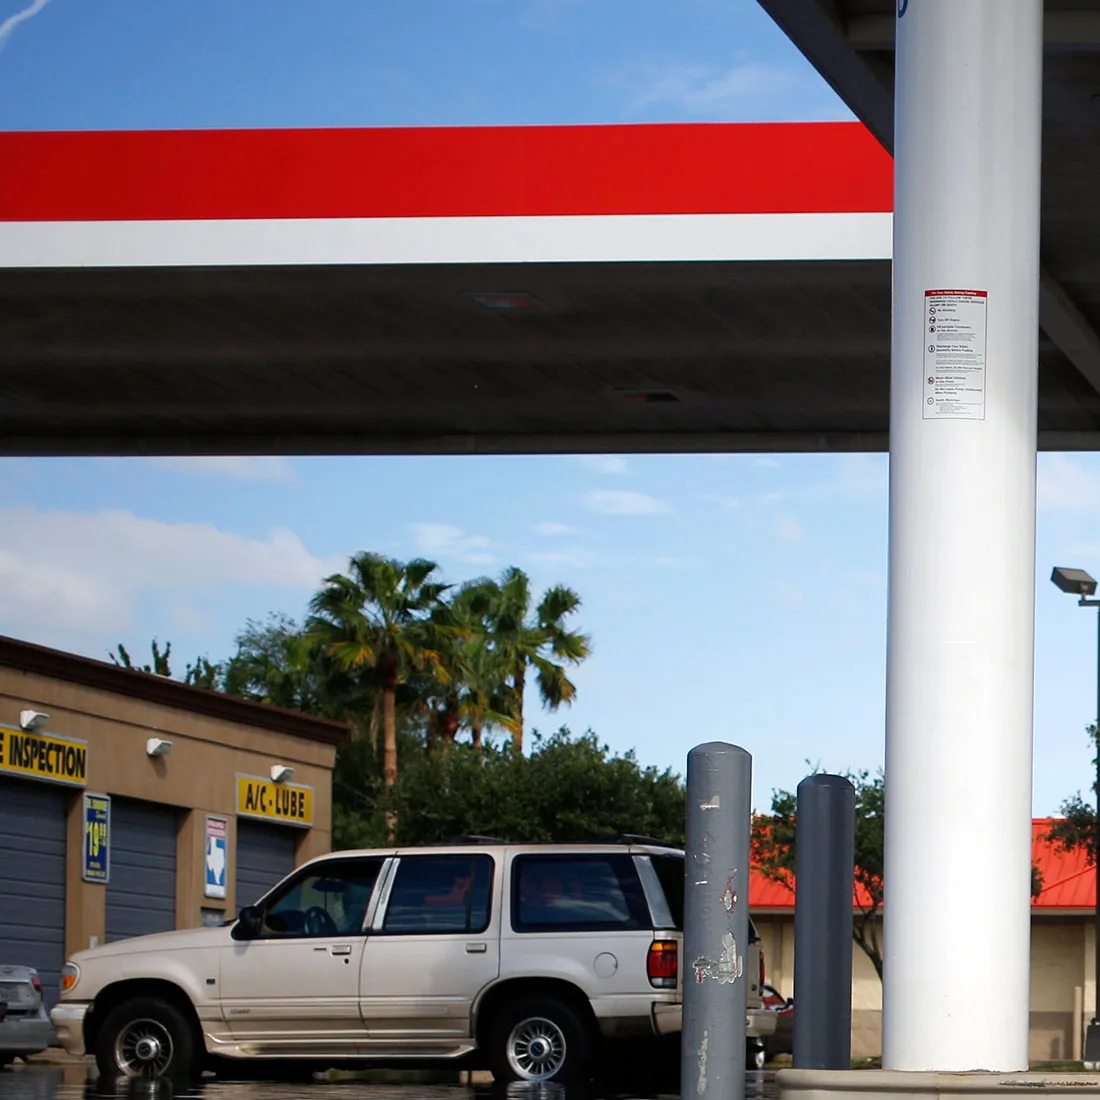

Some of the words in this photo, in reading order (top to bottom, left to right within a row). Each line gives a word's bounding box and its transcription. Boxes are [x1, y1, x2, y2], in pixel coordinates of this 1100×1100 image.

[9, 735, 86, 778] INSPECTION
[246, 784, 266, 812] A/C
[276, 788, 304, 818] LUBE
